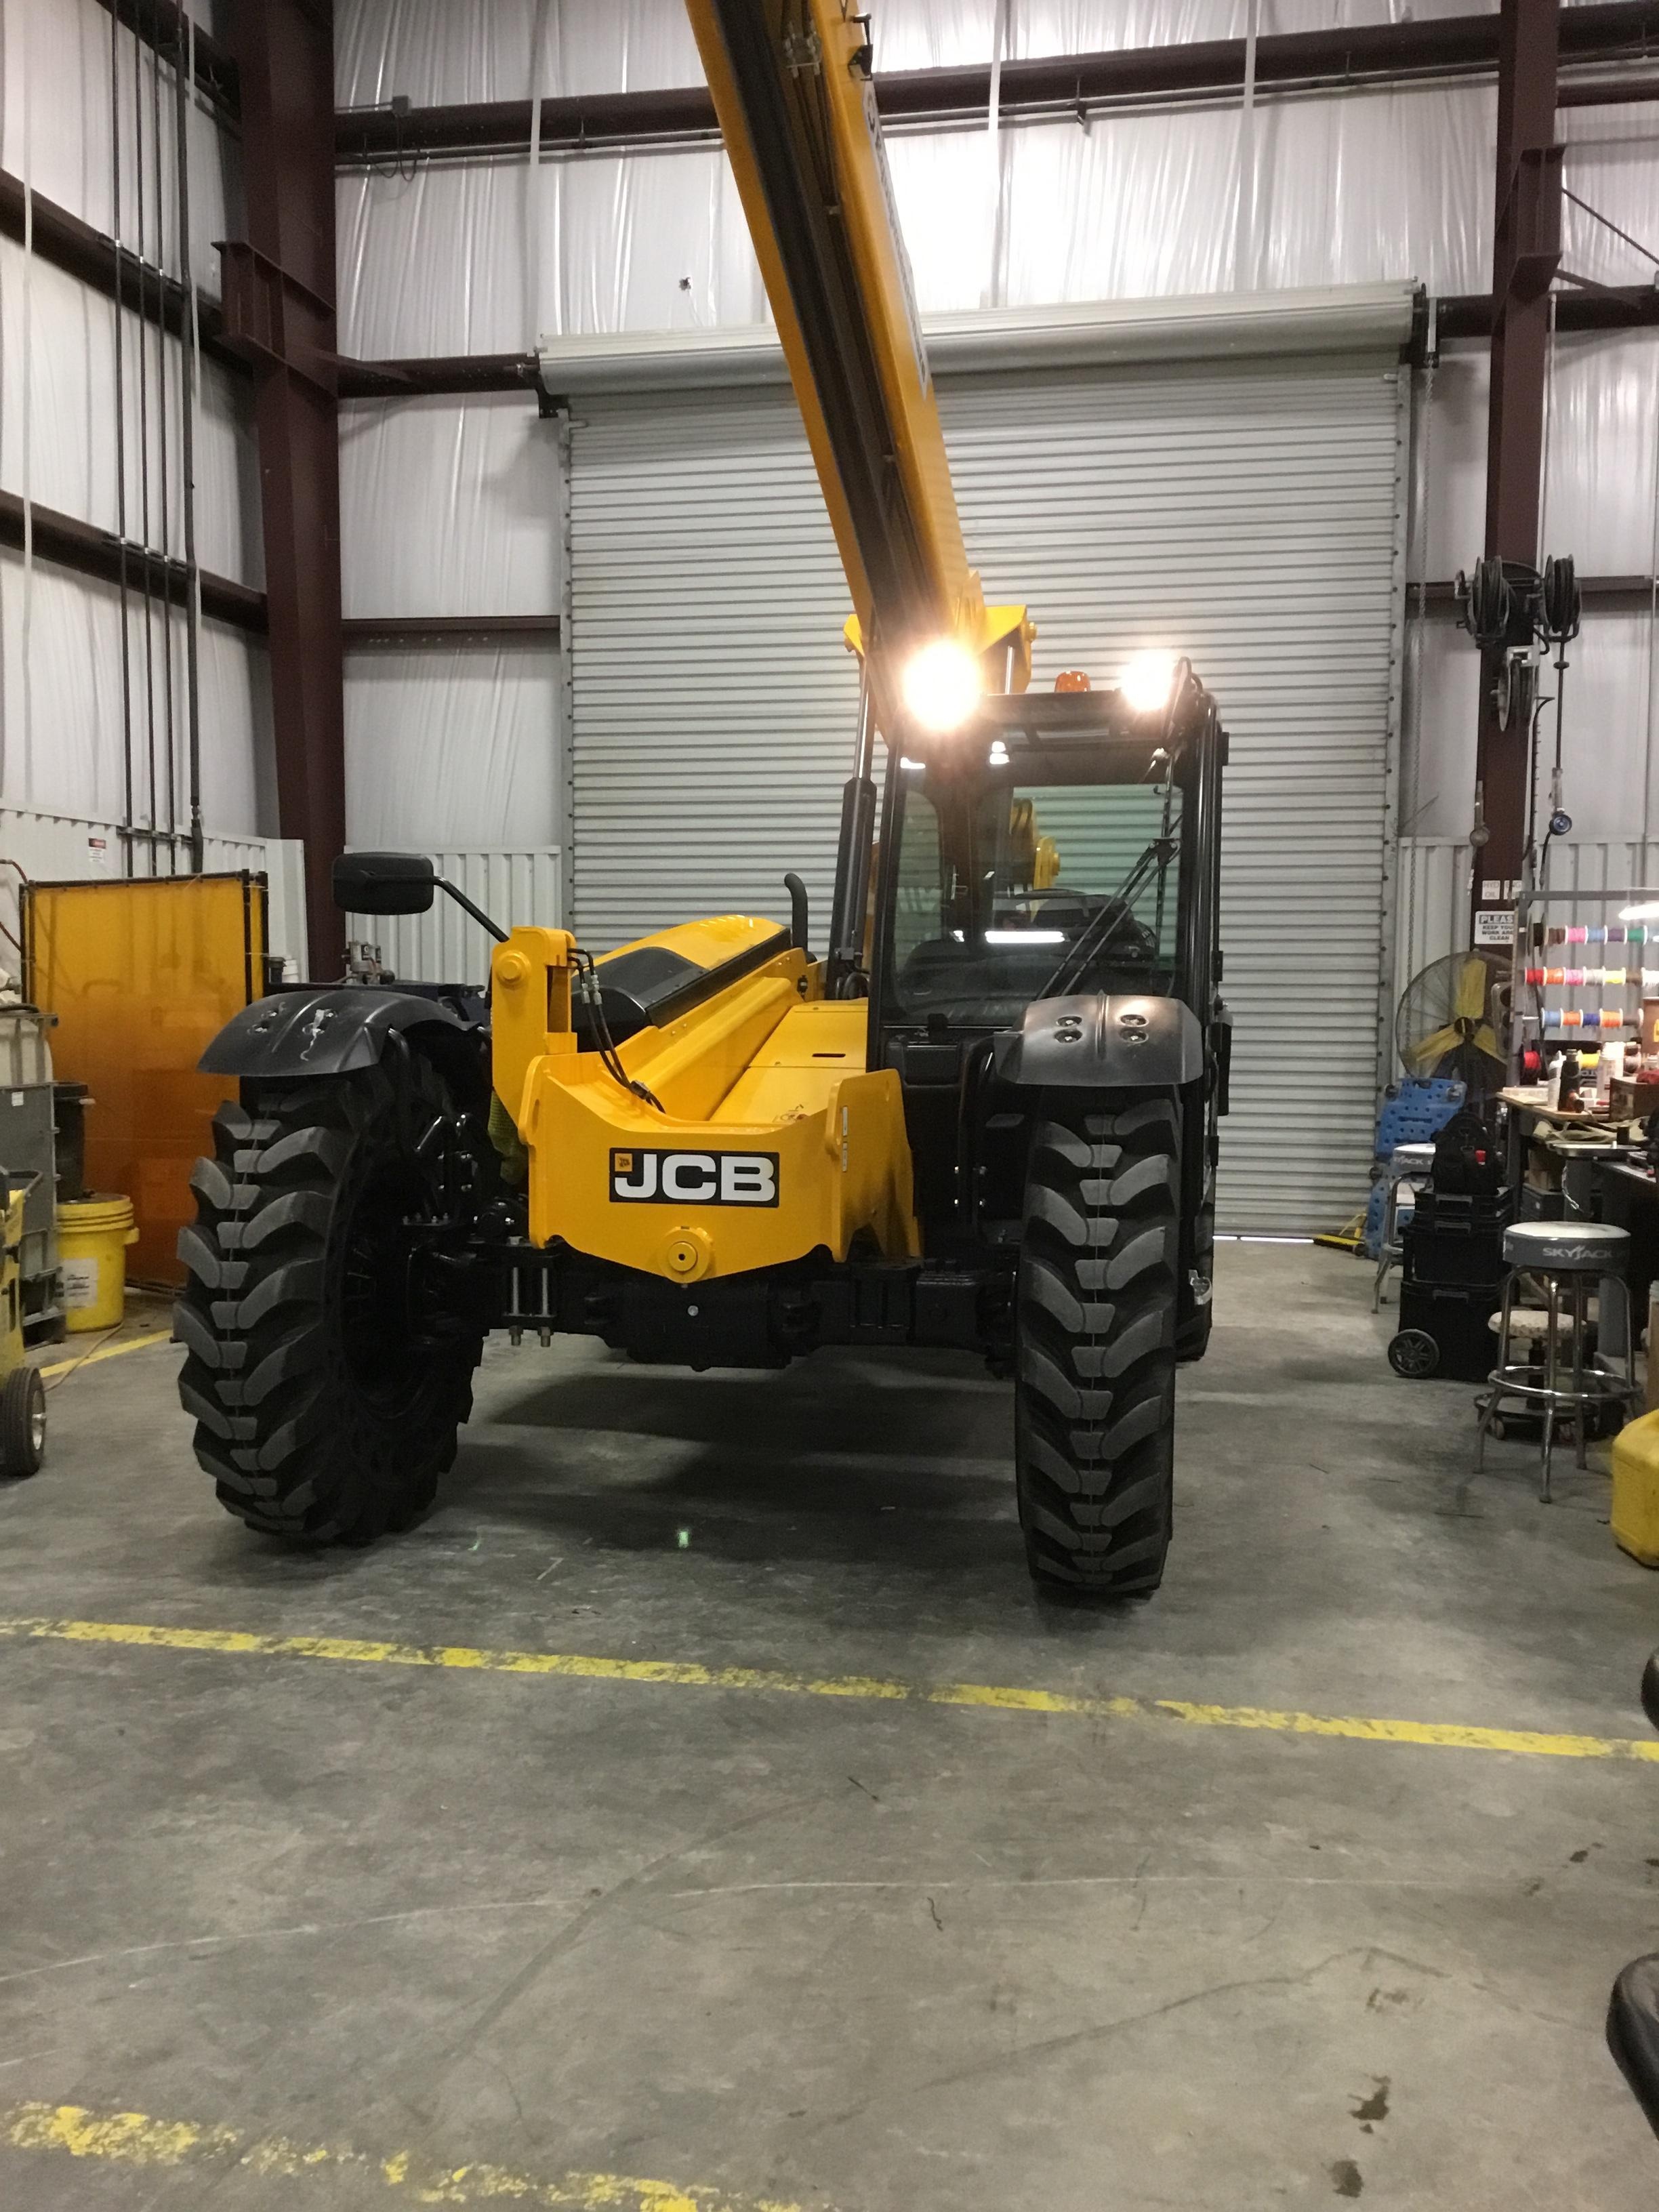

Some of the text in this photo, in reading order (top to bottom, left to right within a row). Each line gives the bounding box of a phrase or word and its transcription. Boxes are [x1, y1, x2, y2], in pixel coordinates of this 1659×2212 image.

[1481, 916, 1513, 924] PLEAS
[614, 1153, 776, 1202] JCB
[1542, 1245, 1613, 1261] SKYJACK
